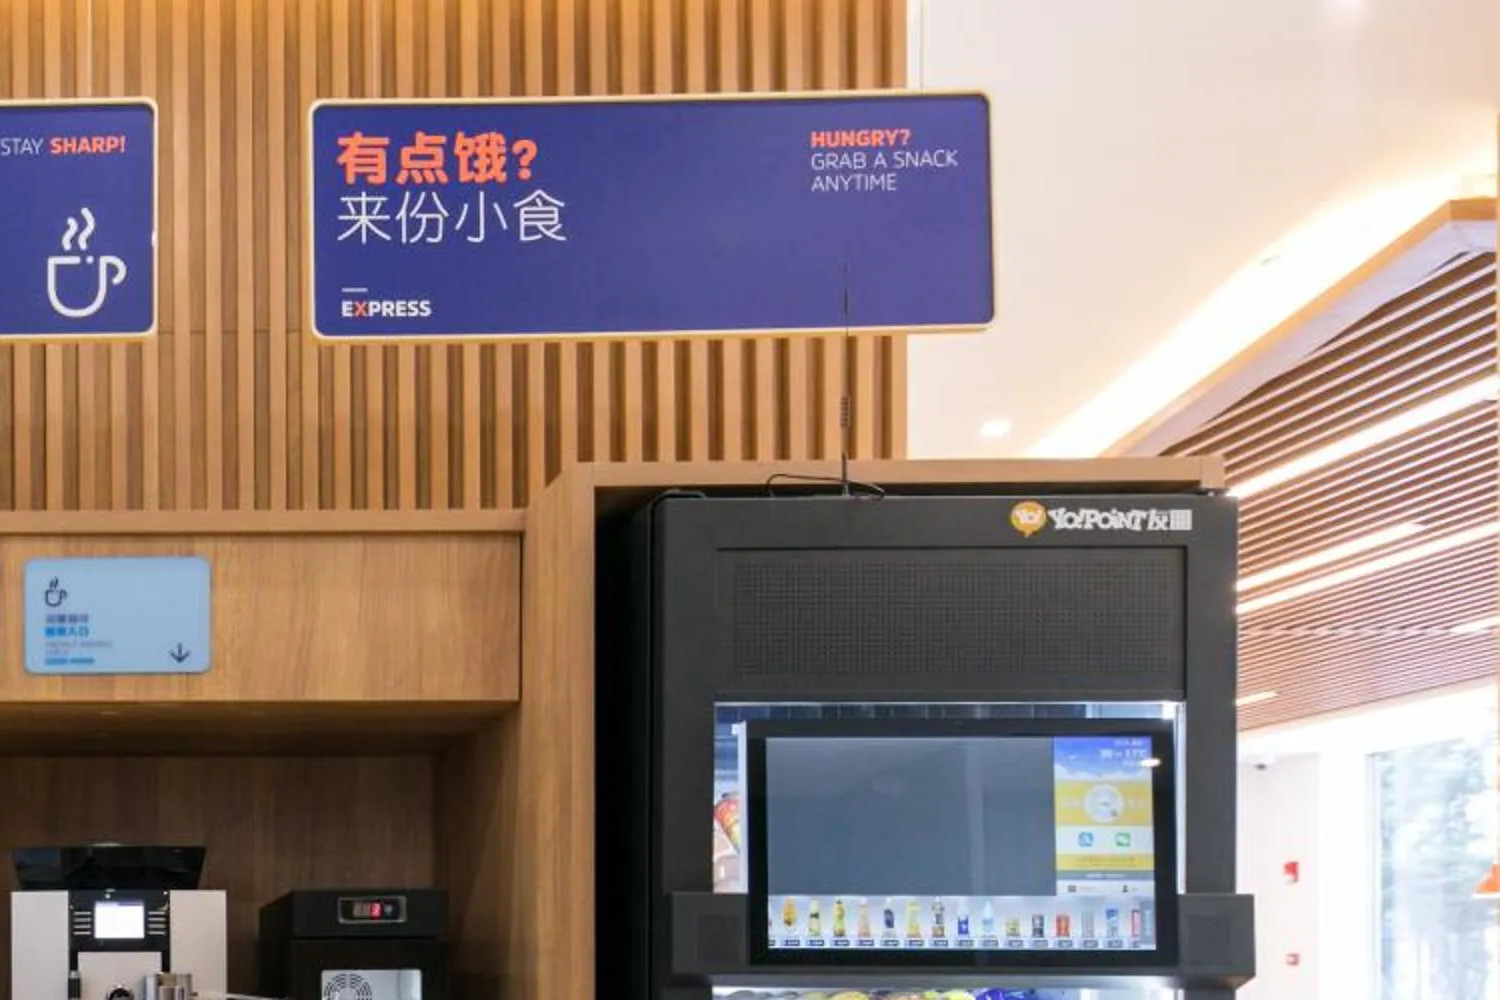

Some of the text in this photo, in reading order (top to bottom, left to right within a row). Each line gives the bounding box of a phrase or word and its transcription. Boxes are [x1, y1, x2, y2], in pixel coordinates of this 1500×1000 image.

[0, 135, 126, 156] STAY SHARP!
[810, 129, 911, 148] HUNGRY?
[336, 132, 539, 185] 有点饿?
[811, 149, 959, 171] GRAB A SNACK
[811, 172, 897, 192] ANYTIME
[337, 189, 567, 244] 来份小食
[341, 300, 432, 317] EXPRESS
